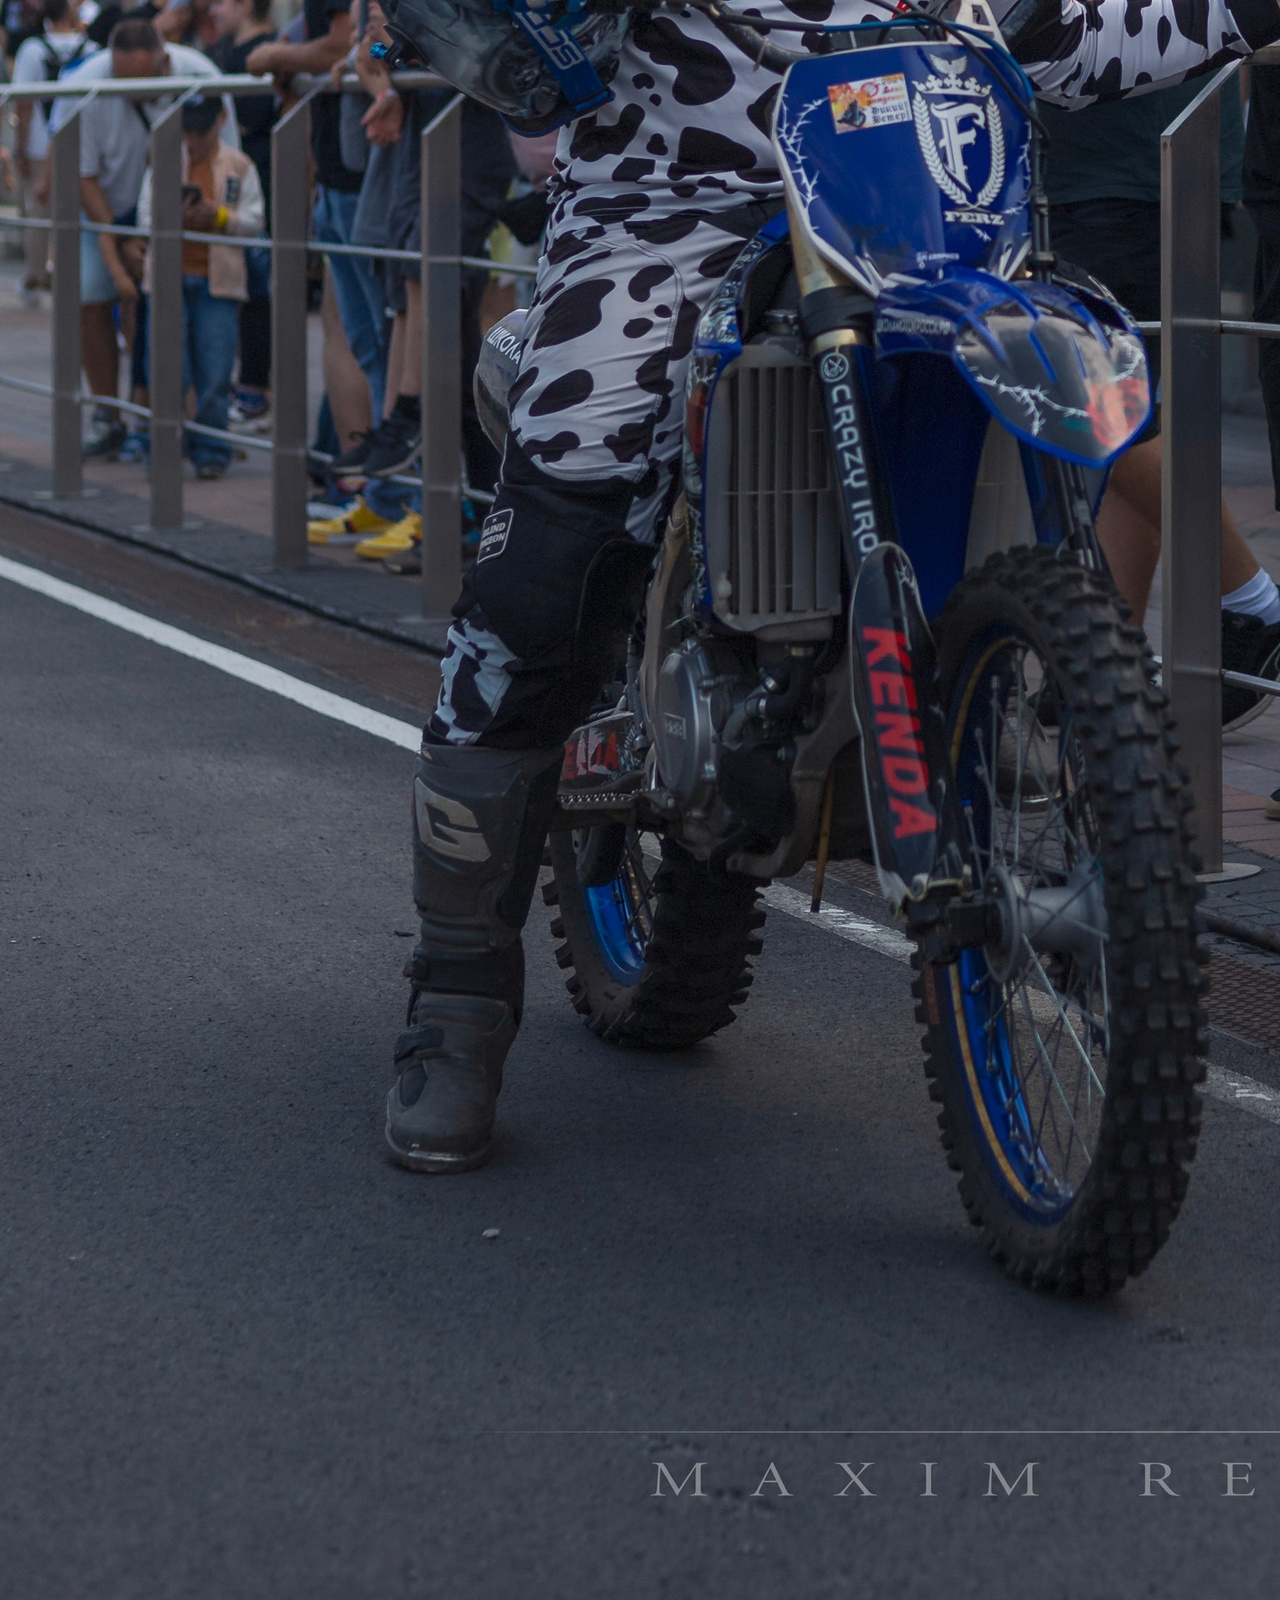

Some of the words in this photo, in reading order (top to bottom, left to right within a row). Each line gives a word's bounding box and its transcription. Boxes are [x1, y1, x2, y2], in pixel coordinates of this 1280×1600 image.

[943, 210, 1005, 226] FERZ
[831, 383, 869, 491] CRAZY
[851, 499, 881, 568] IRO
[862, 626, 939, 839] KENDA
